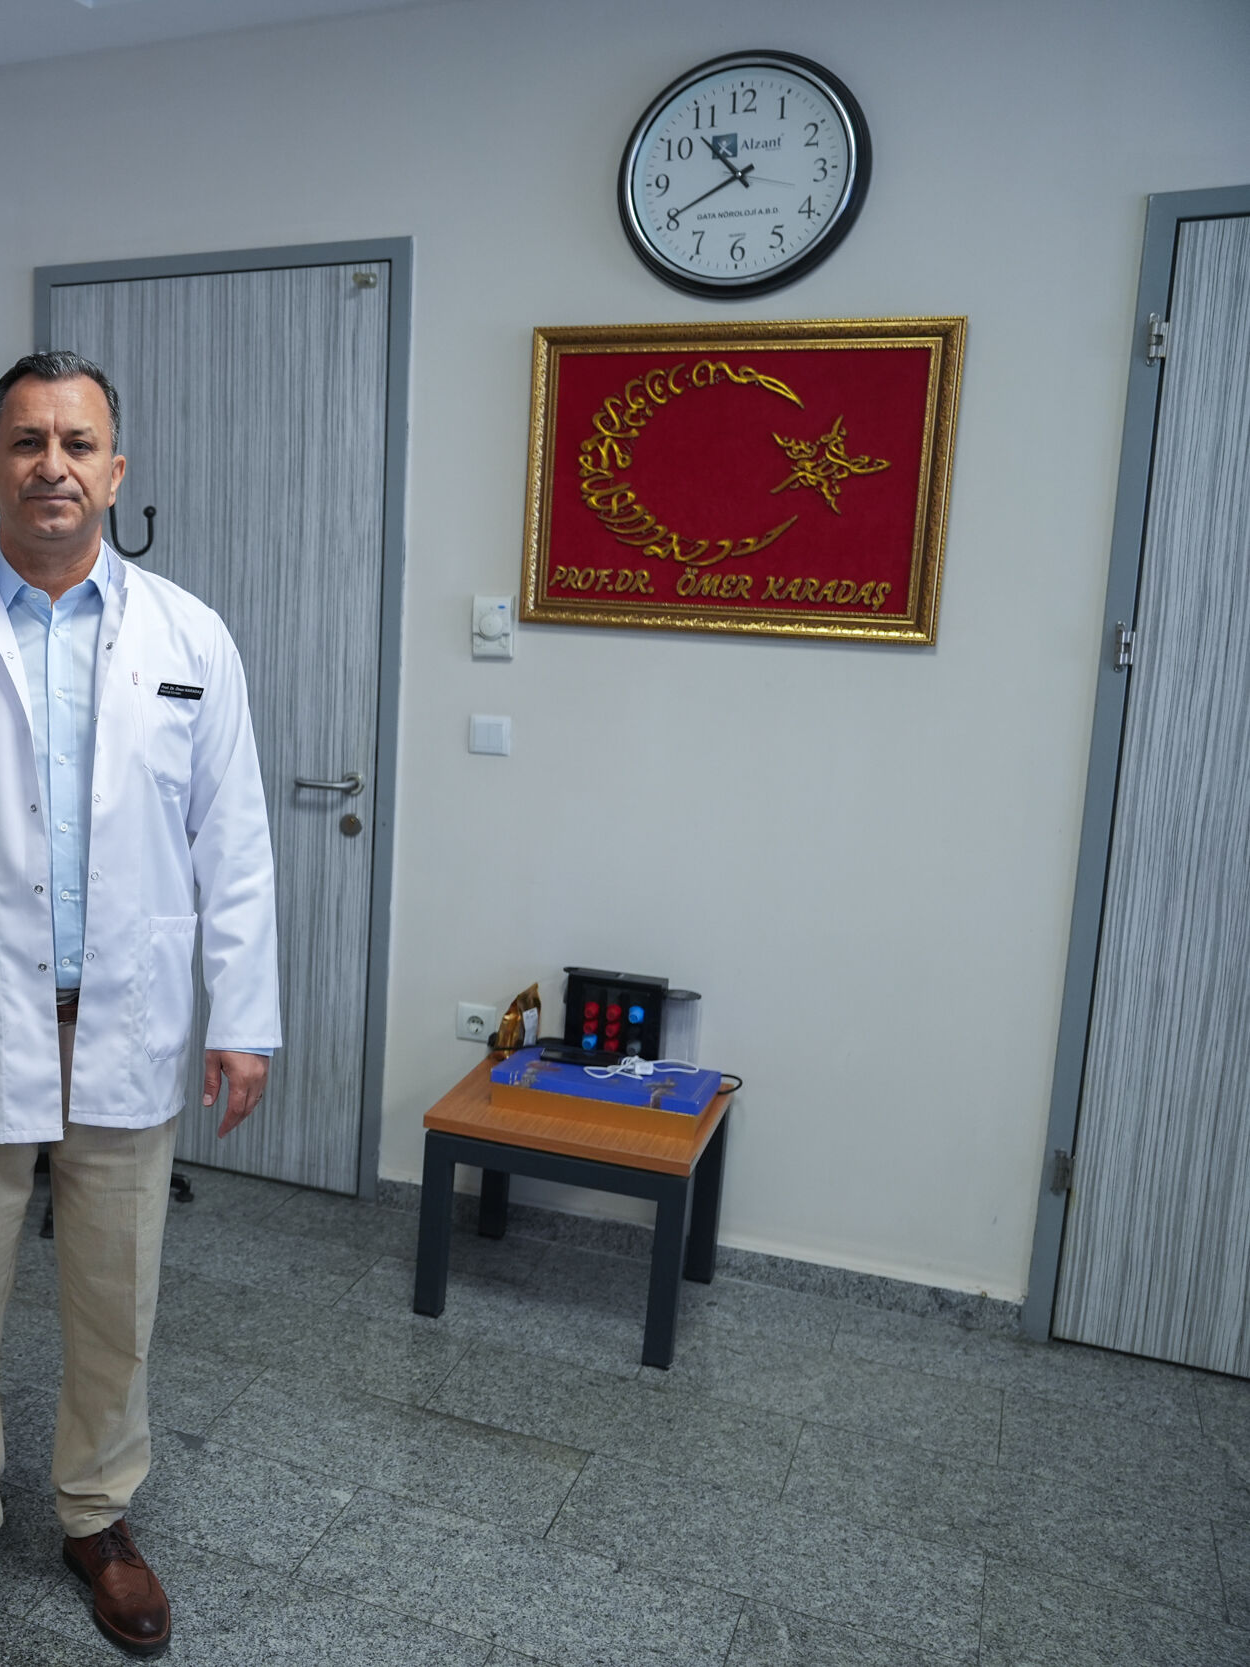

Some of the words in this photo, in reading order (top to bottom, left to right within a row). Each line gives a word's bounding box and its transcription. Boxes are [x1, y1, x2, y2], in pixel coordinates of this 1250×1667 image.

[729, 88, 757, 115] 12
[777, 95, 788, 120] 1
[692, 104, 717, 130] 11
[804, 121, 820, 148] 2
[664, 136, 693, 162] 10
[813, 158, 828, 182] 3
[655, 173, 670, 198] 9
[666, 207, 680, 232] 8
[797, 194, 816, 220] 4
[691, 230, 706, 256] 7
[729, 236, 746, 262] 6
[768, 224, 785, 249] 5
[549, 564, 654, 594] PROF.DR.
[676, 566, 754, 599] ÖMER
[760, 574, 893, 612] KARADAŞ
